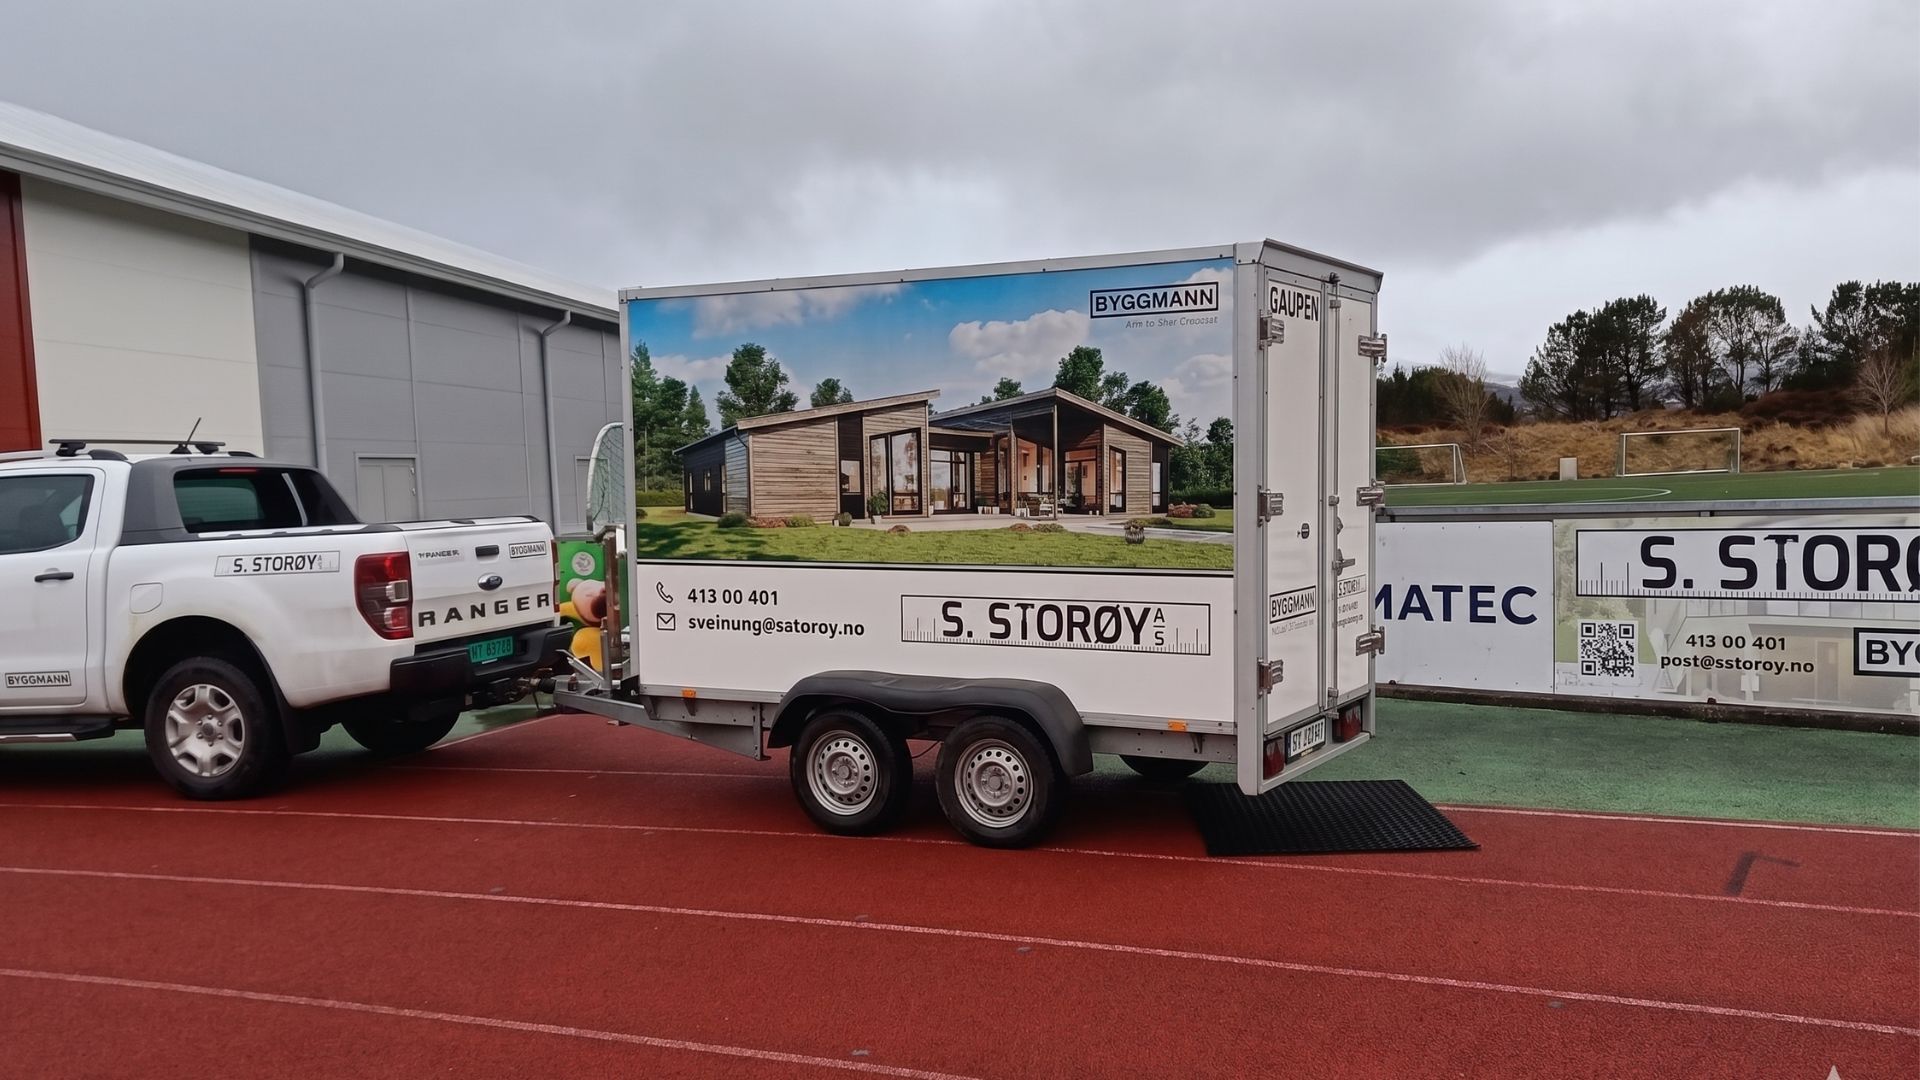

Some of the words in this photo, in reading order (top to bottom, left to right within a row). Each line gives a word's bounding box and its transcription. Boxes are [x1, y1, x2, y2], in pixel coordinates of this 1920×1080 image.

[1095, 288, 1213, 312] BYGGMANN
[1270, 286, 1319, 321] GAUPEN
[1146, 319, 1155, 328] to
[233, 558, 248, 573] S.
[252, 554, 317, 572] STORØY
[1640, 536, 1694, 589] S.
[687, 588, 717, 603] 413
[722, 589, 743, 605] 00
[748, 590, 779, 606] 401
[1271, 591, 1315, 618] BYGGMANN
[418, 593, 550, 627] RANGER
[688, 614, 865, 639] sveinung@satoroy.no
[941, 601, 973, 638] S.
[988, 602, 1152, 645] STORØY
[1686, 634, 1716, 648] 413
[1722, 635, 1746, 649] 00
[1752, 637, 1786, 651] 401
[1660, 655, 1815, 675] post@sstoroy.no
[7, 674, 69, 685] BYGGMANN
